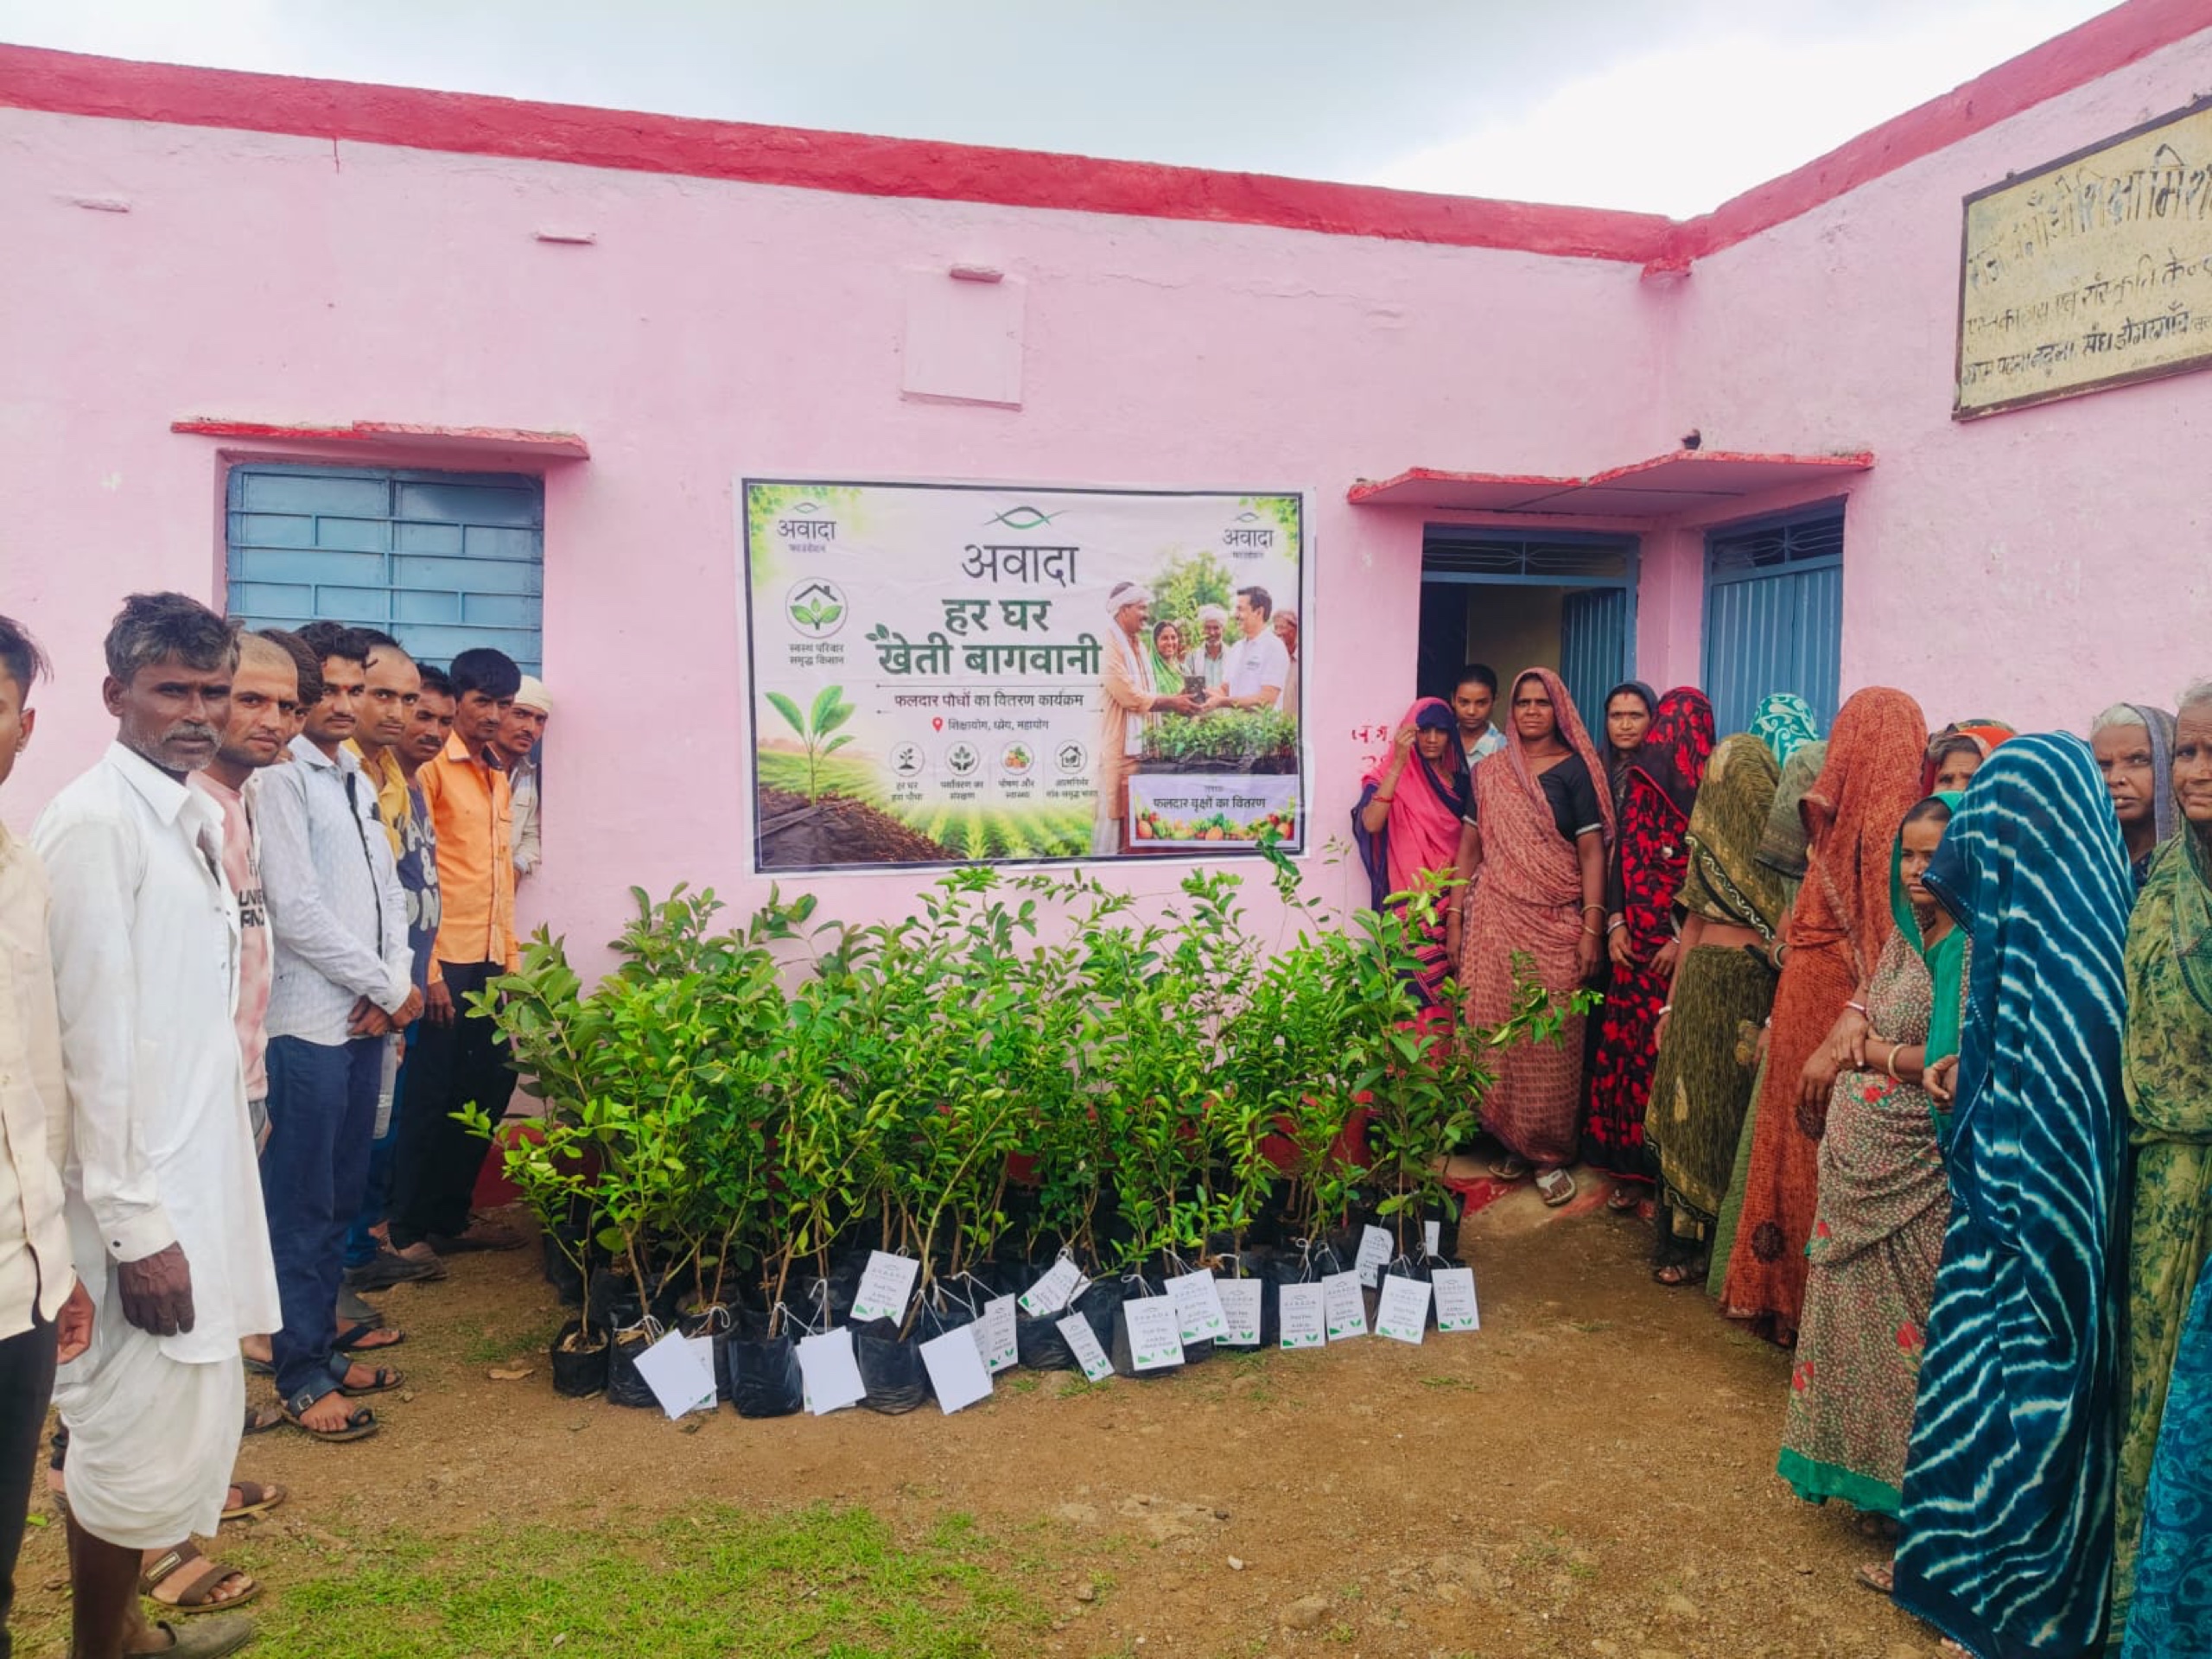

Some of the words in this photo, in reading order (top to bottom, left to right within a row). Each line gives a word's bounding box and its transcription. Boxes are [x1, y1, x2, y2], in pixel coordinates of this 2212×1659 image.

[777, 520, 837, 542] अवादा
[1222, 529, 1274, 549] अवादा
[962, 544, 1080, 588] अवादा
[942, 599, 991, 636] हर
[998, 599, 1052, 632] घर
[815, 641, 844, 653] परिवार
[875, 631, 955, 675] खेती
[962, 632, 1103, 675] बागवानी
[789, 656, 814, 668] समृद्ध
[815, 654, 844, 664] किसान
[894, 695, 940, 708] फलदार
[974, 695, 991, 707] का
[994, 690, 1035, 708] वितरण
[1038, 690, 1084, 707] कार्यक्रम
[1216, 798, 1230, 808] का
[1232, 795, 1267, 808] वितरण
